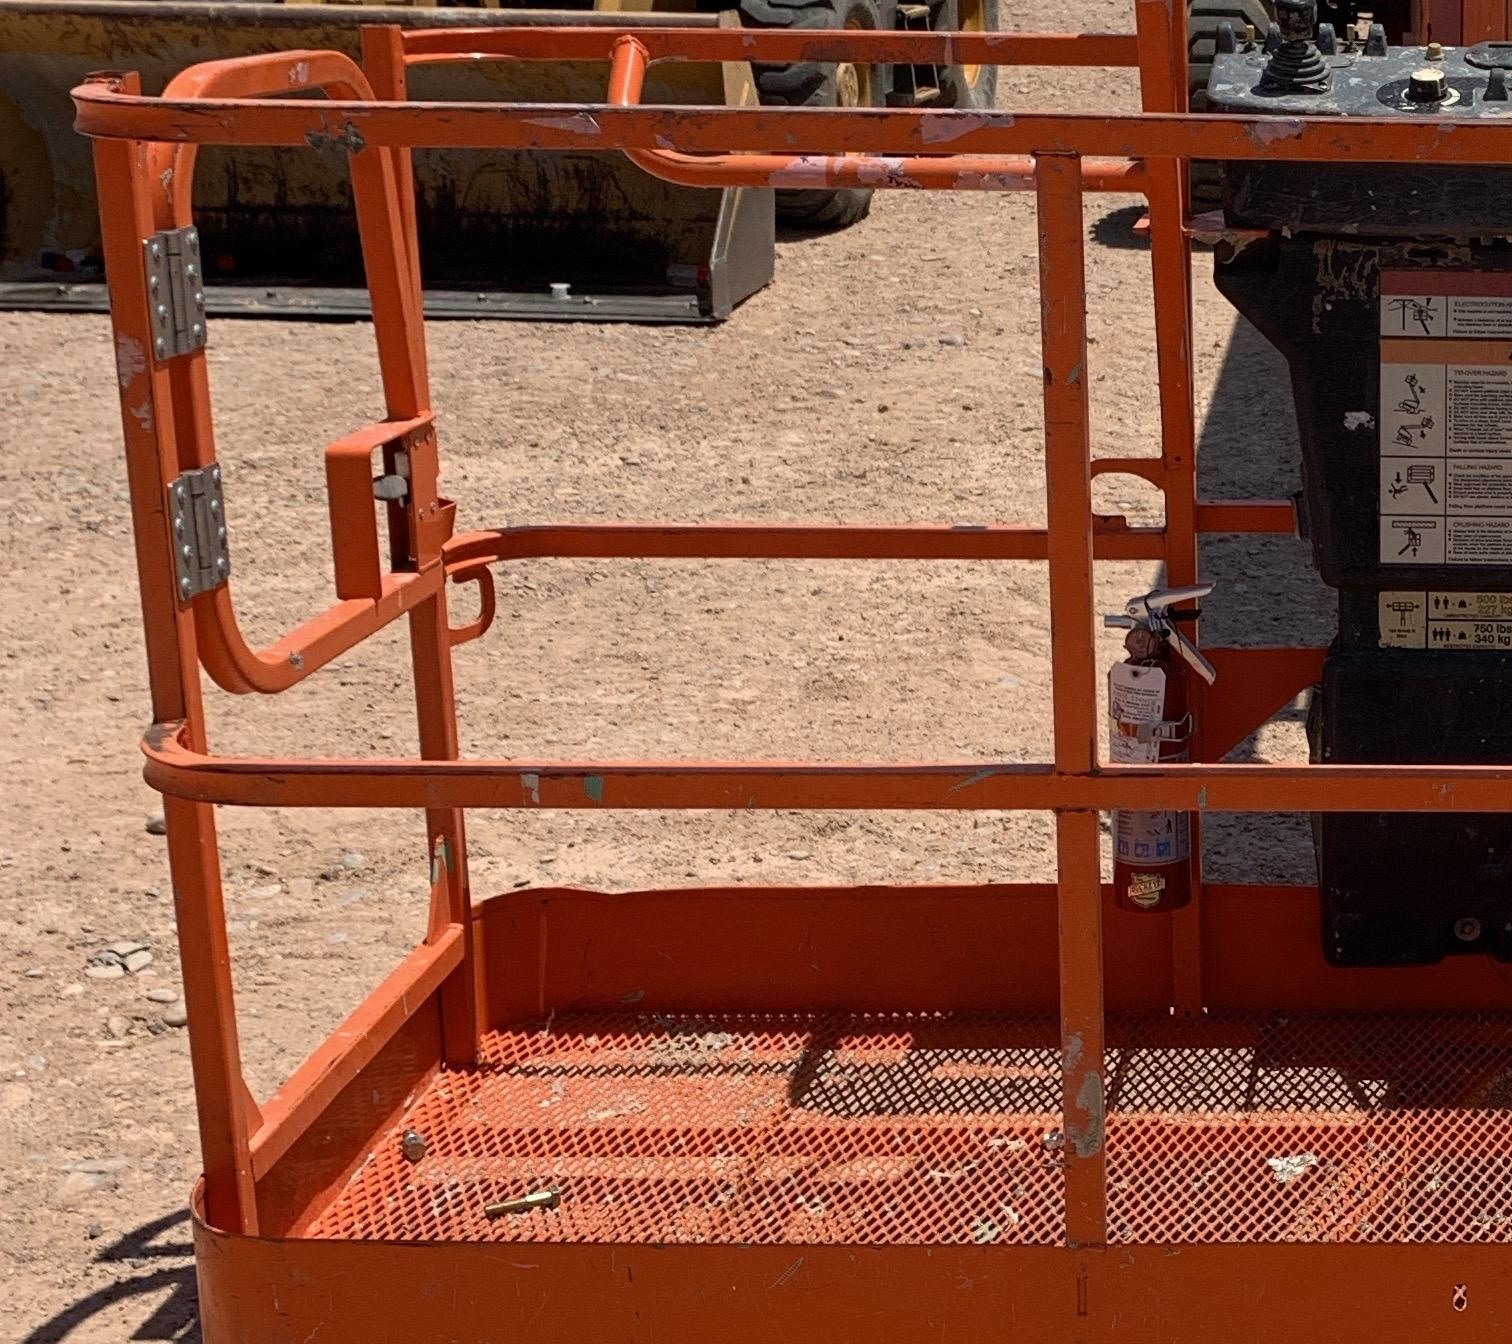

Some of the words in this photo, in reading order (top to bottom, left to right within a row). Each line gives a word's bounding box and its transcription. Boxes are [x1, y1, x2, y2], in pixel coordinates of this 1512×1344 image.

[1478, 605, 1498, 615] 227
[1500, 605, 1512, 616] kg
[1473, 624, 1493, 633] 750
[1496, 624, 1512, 633] lbs
[1474, 634, 1494, 644] 340
[1497, 634, 1511, 646] kg
